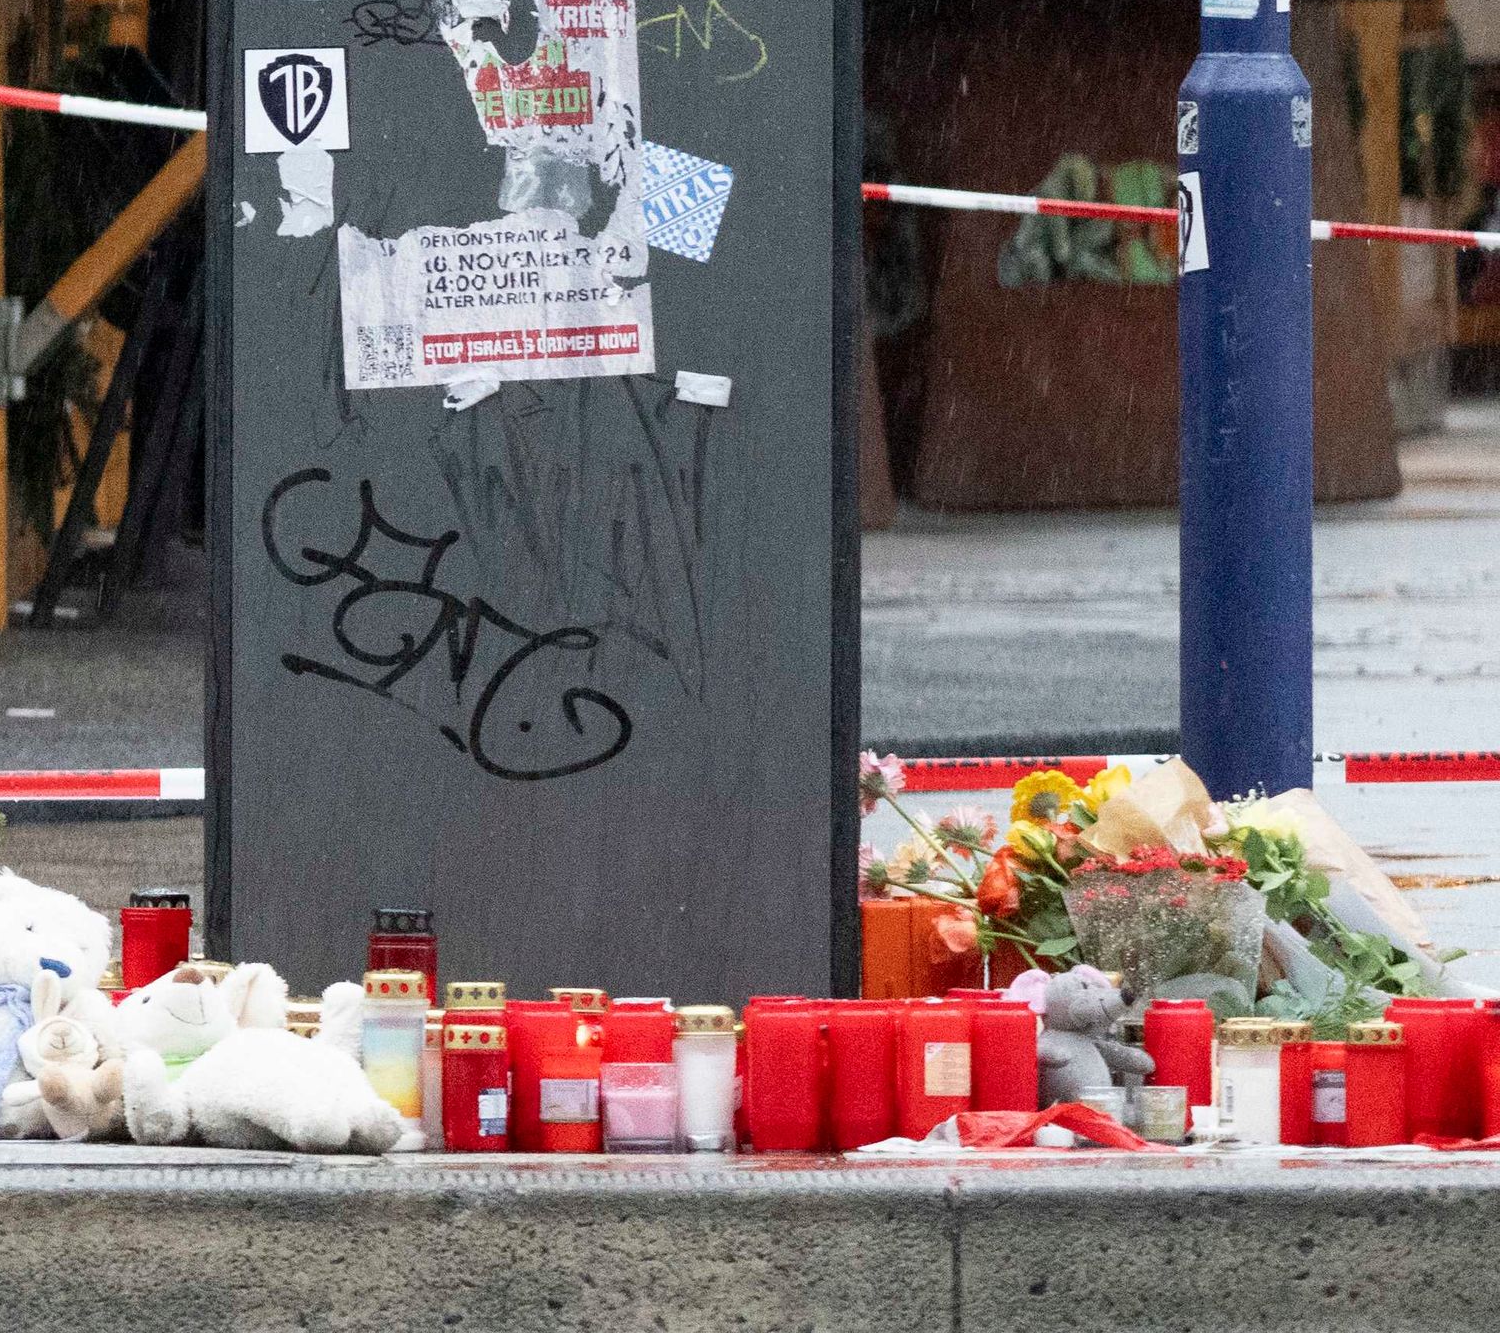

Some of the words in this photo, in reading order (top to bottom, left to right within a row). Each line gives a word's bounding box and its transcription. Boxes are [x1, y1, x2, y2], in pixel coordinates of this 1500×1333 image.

[426, 274, 486, 293] 14:00
[493, 272, 540, 289] UHR
[424, 294, 474, 309] ALTER
[479, 291, 536, 306] MARKT
[425, 341, 462, 359] STOP
[537, 334, 595, 353] CRIMES
[600, 332, 638, 350] NOW!
